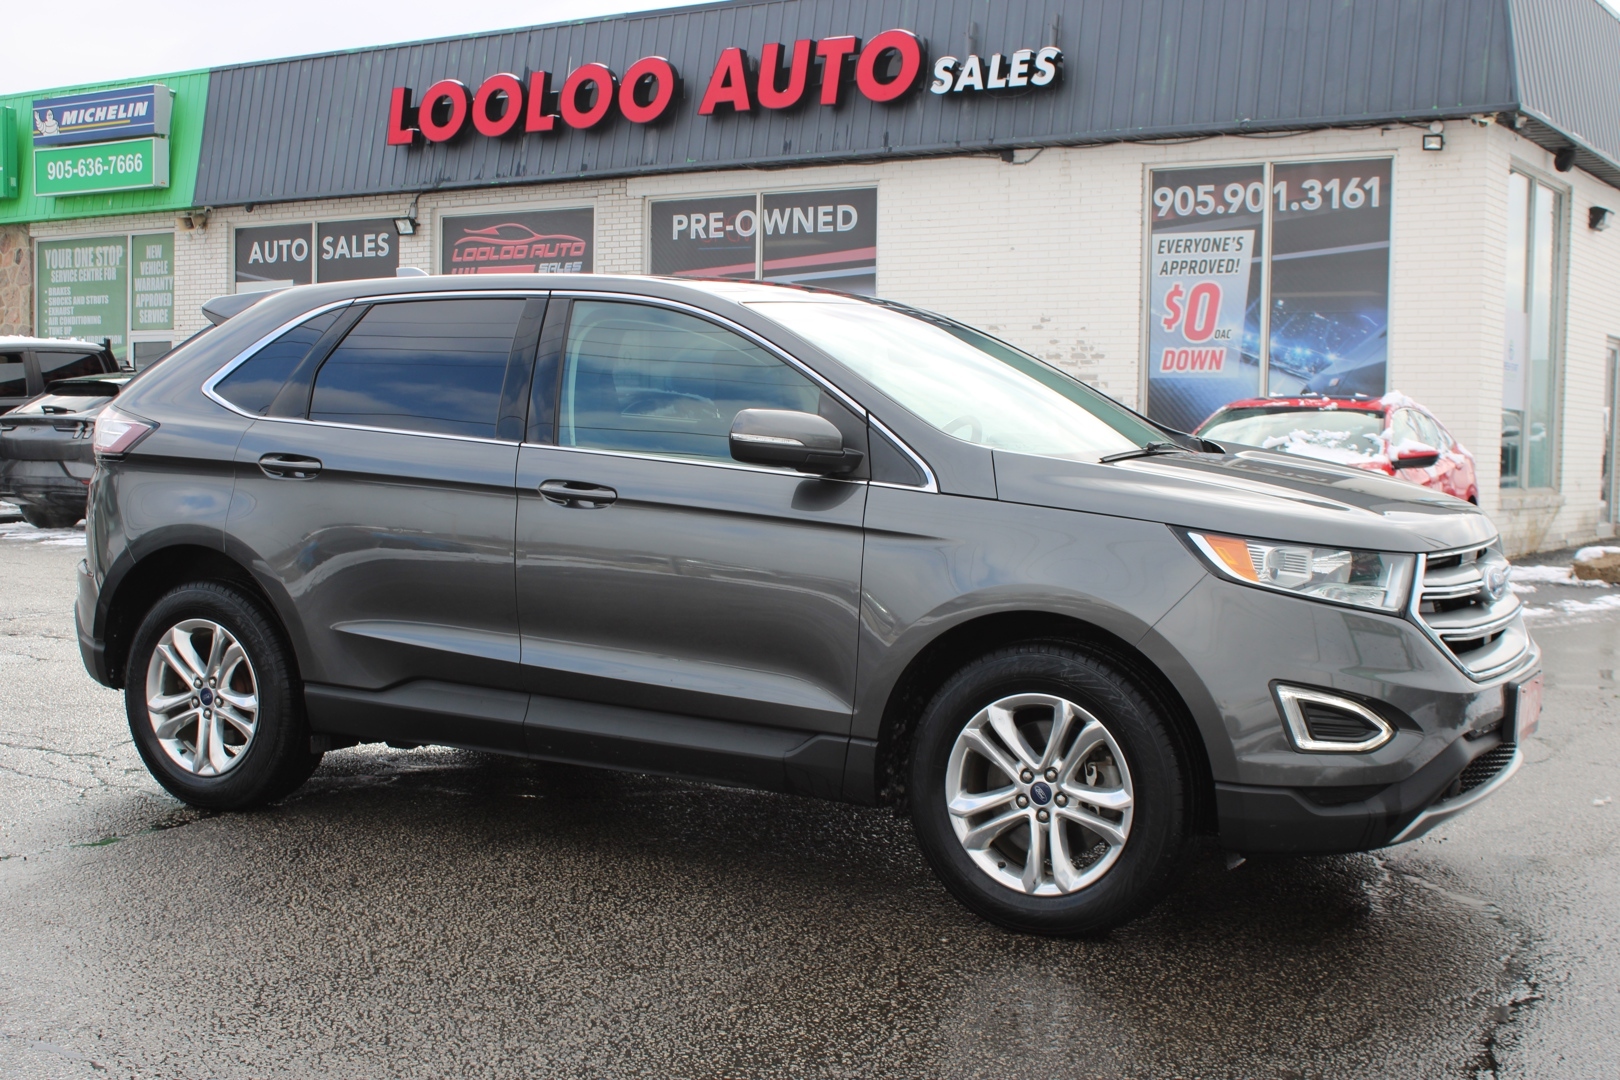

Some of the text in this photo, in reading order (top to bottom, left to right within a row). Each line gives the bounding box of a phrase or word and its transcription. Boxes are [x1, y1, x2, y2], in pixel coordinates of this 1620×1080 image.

[387, 29, 1061, 146] LOOLOO AUTO SALES
[61, 101, 149, 126] MICHELIN
[47, 153, 143, 180] 905-636-7666
[1153, 176, 1380, 216] 905.901.3161
[672, 204, 858, 241] PRE-OWNED
[146, 244, 162, 259] NEW
[248, 232, 390, 264] AUTO SALES
[453, 242, 585, 262] LOOLOO AUTO
[1157, 236, 1244, 255] EVERYONE'S
[45, 245, 123, 269] YOUR ONE STOP
[140, 260, 168, 275] VEHICLE
[539, 261, 582, 273] SALES
[1159, 258, 1240, 275] APPROVED!
[51, 267, 116, 283] SERVICE CENTRE FOR
[48, 287, 71, 297] BRAKES
[134, 276, 173, 292] WARRANTY
[48, 295, 109, 306] SHOCKS AND STRUTS
[135, 292, 172, 308] APPROVED
[48, 306, 74, 316] EXHAUST
[139, 309, 168, 323] SERVICE
[1163, 283, 1220, 340] $0
[48, 315, 102, 326] AIR CONDITIONING
[48, 326, 72, 336] TUNE UP
[1214, 328, 1231, 339] OAC
[1161, 349, 1224, 370] DOWN
